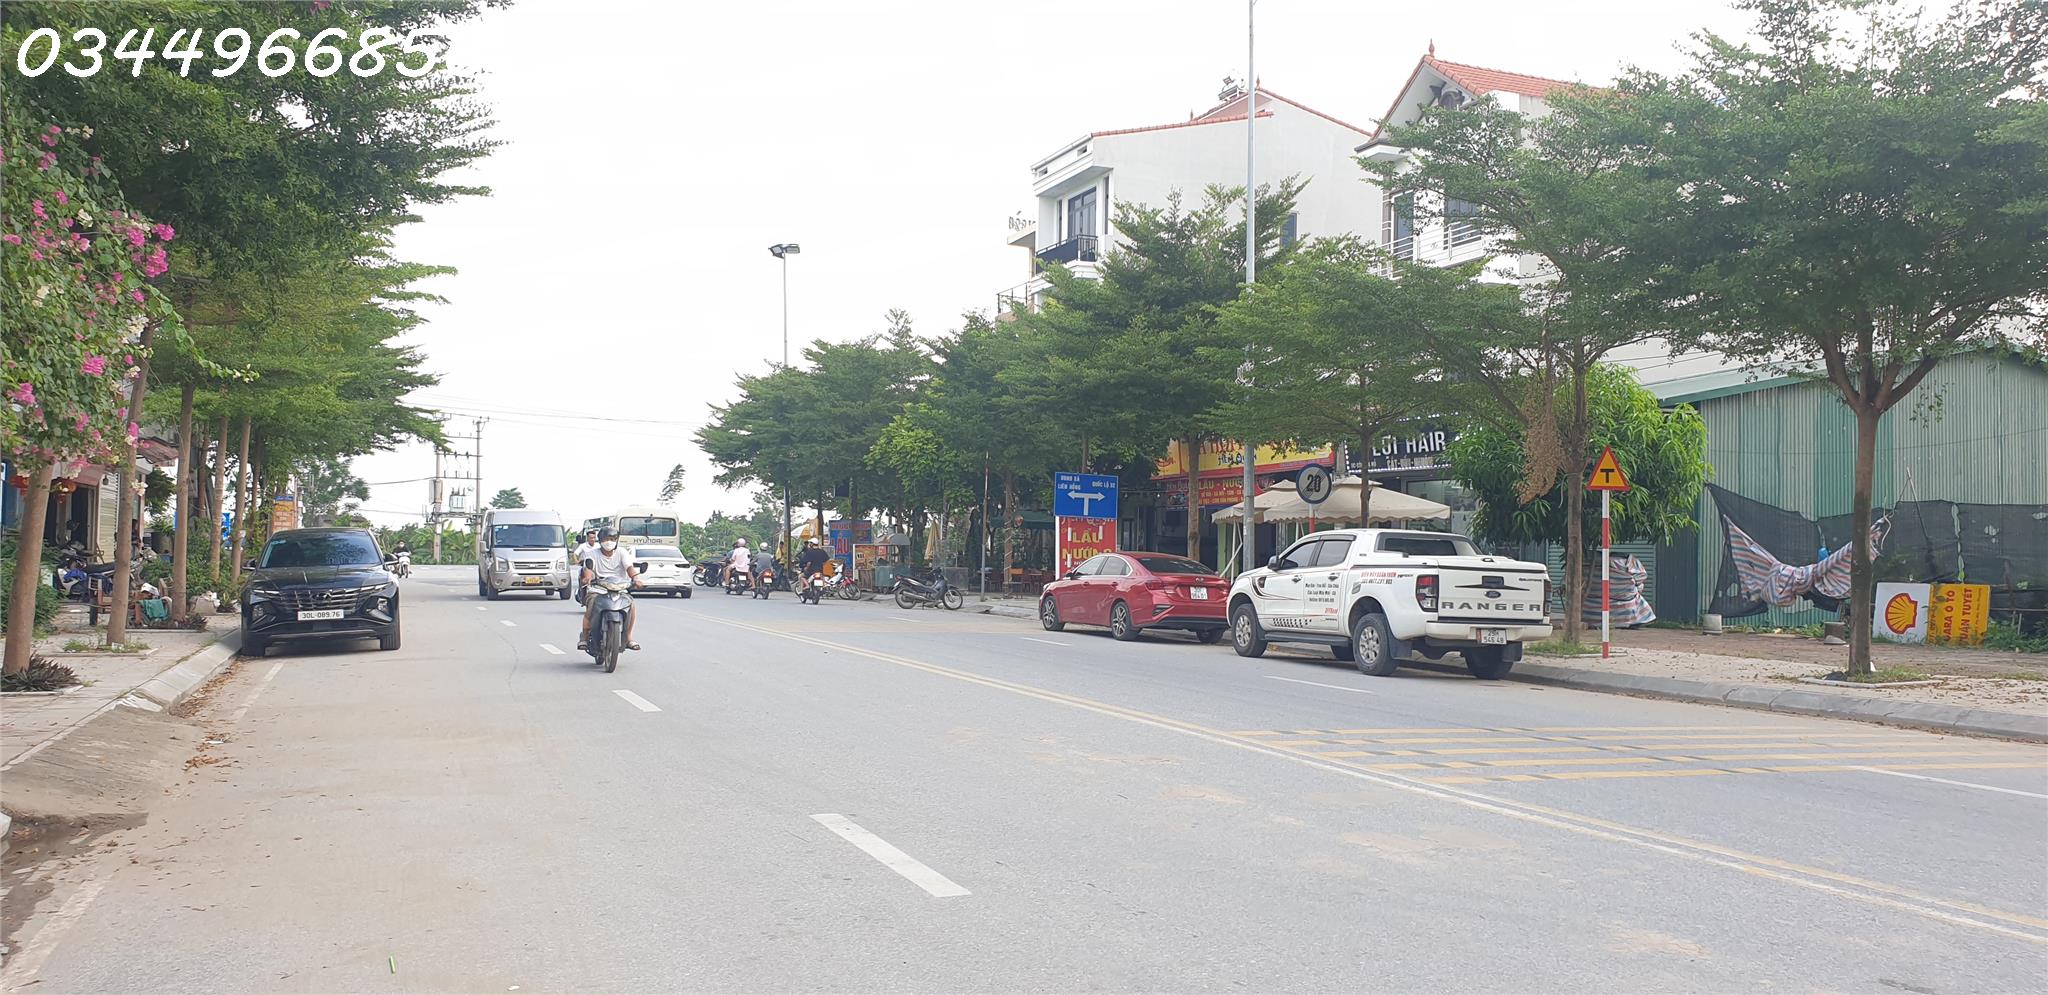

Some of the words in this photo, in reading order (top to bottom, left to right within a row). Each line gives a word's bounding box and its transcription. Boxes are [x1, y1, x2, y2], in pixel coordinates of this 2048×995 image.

[1406, 431, 1446, 454] HAIR
[1307, 474, 1321, 492] 20
[1441, 601, 1541, 611] RANGER
